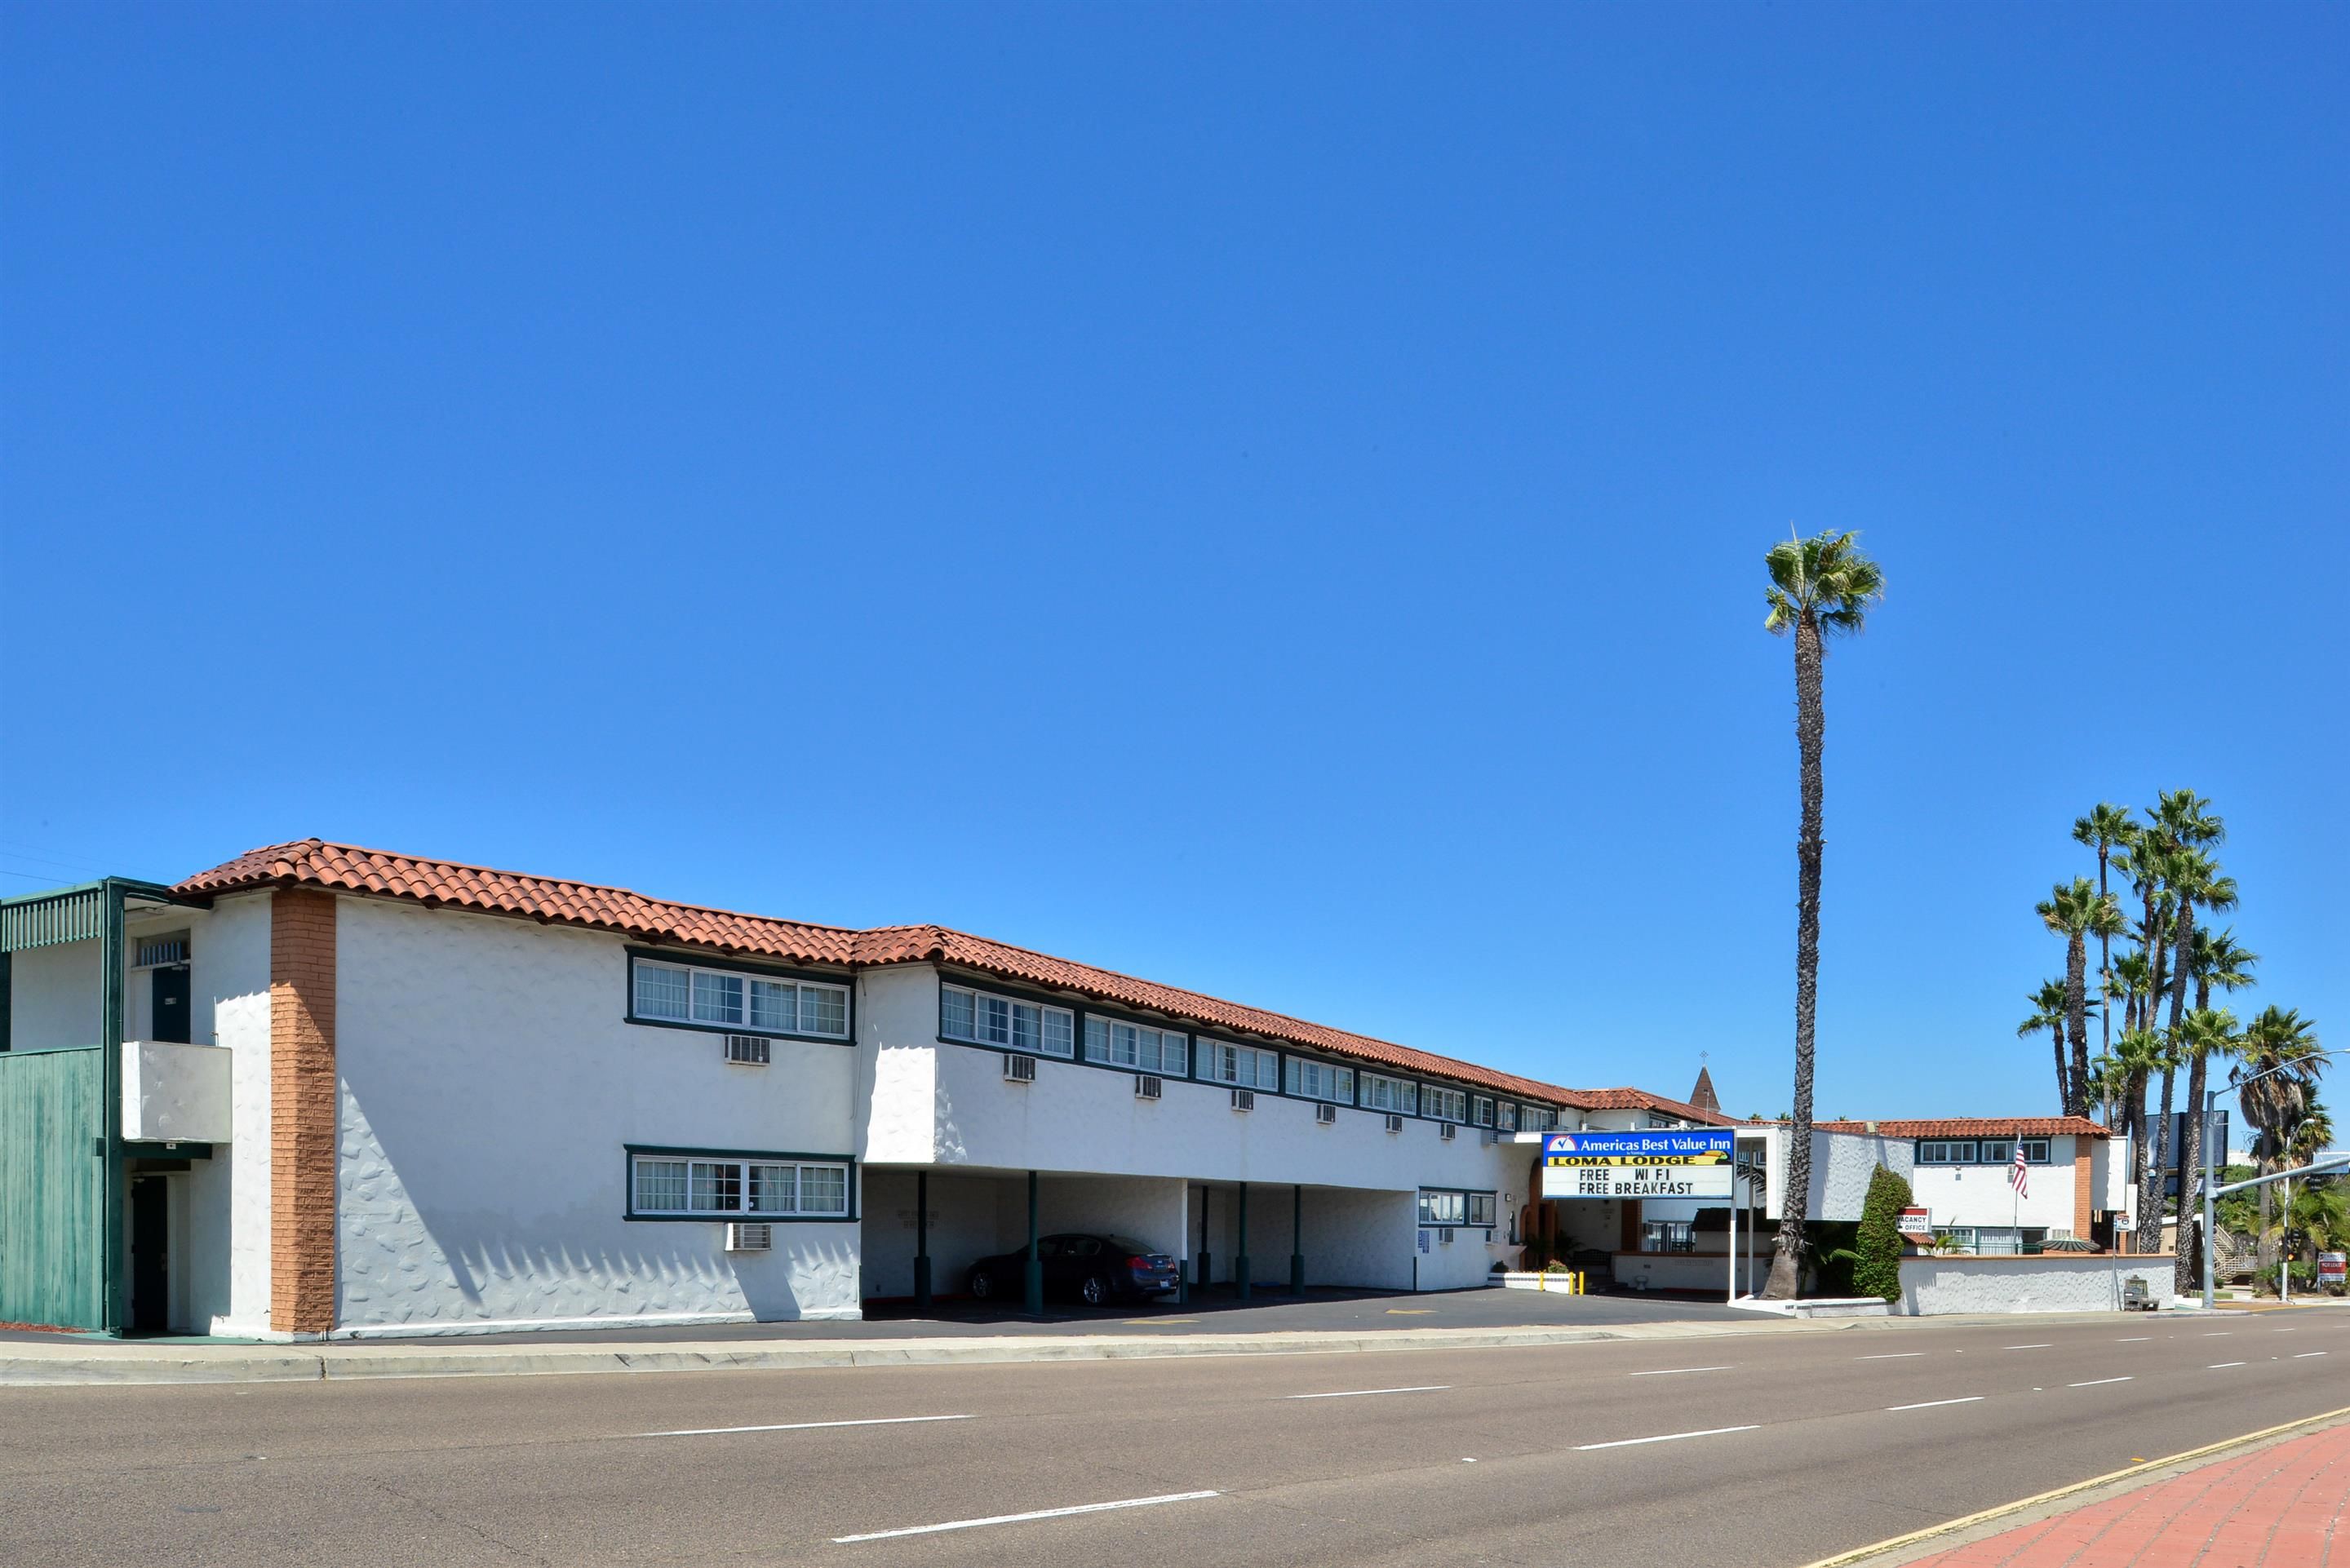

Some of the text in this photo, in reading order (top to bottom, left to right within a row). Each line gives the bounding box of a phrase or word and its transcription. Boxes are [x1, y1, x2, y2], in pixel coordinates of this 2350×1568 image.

[1581, 1137, 1731, 1151] Americas Best Value Inn
[1554, 1156, 1696, 1166] LOMA LODGE
[1580, 1169, 1610, 1181] FREE
[1635, 1168, 1648, 1180] WI
[1579, 1182, 1693, 1194] FREE BREAKFAST
